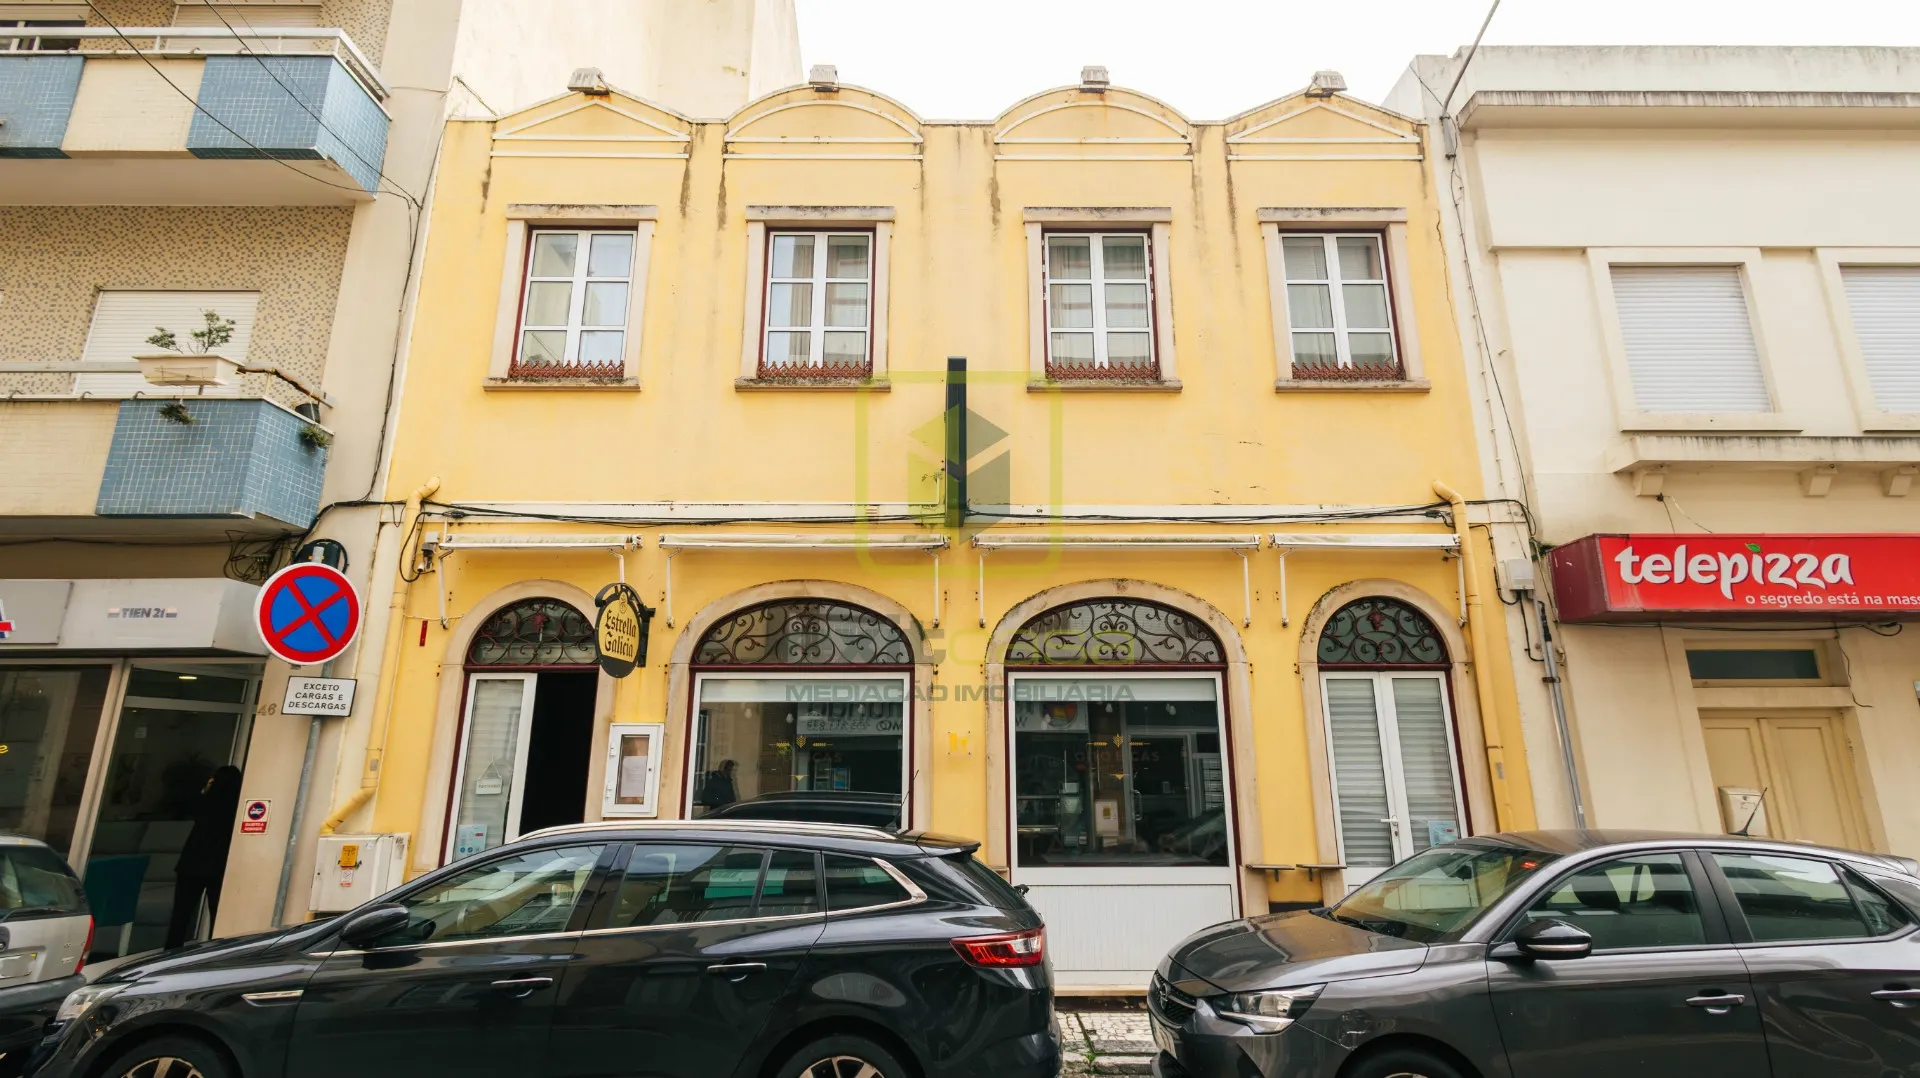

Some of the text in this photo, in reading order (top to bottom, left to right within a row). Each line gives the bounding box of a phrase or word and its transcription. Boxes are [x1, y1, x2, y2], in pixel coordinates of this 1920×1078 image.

[1614, 544, 1854, 600] telepizza
[1745, 594, 1755, 605] o
[1760, 591, 1823, 607] segredo
[1827, 591, 1860, 605] está
[1863, 595, 1883, 605] na
[122, 607, 166, 619] TIEN 21
[605, 609, 636, 638] Estrella
[604, 631, 634, 658] Galicia
[303, 683, 340, 691] EXCETO
[295, 692, 334, 701] CARGAS
[288, 701, 346, 710] DESCARGAS
